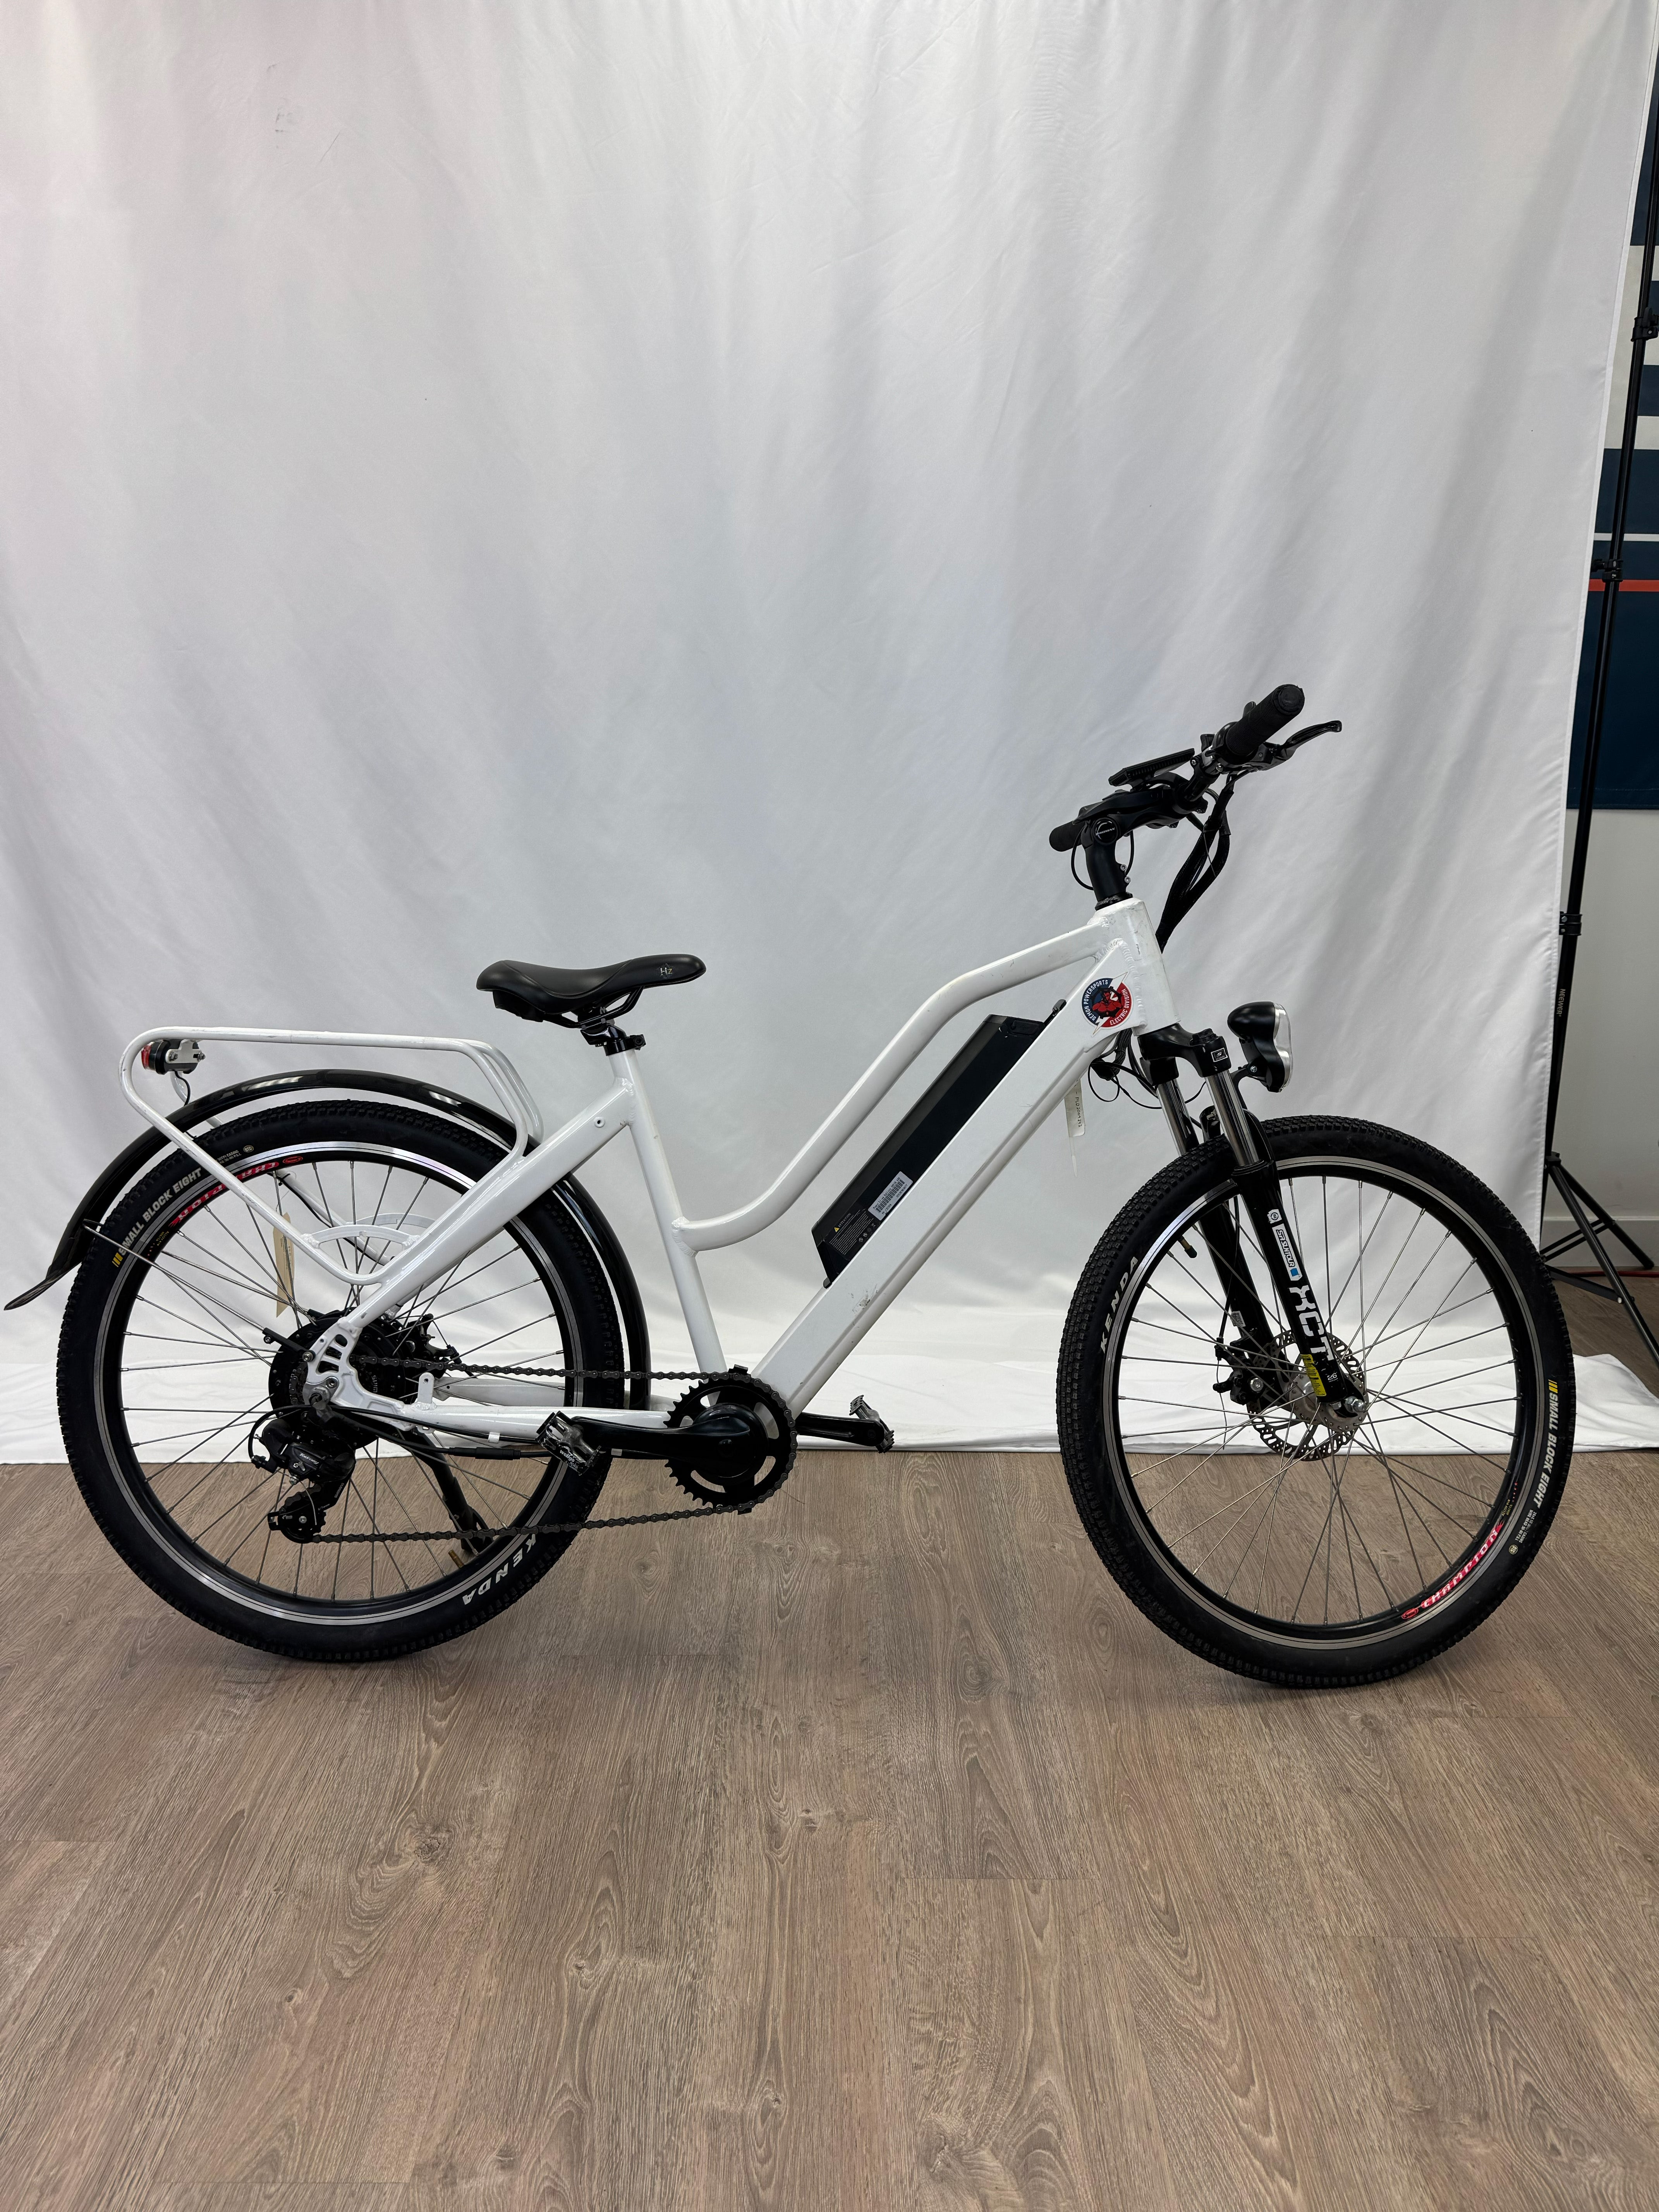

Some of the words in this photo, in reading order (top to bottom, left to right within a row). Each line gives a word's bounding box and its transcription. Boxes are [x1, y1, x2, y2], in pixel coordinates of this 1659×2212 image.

[1084, 980, 1108, 1004] POWERSPORTS
[1110, 1009, 1127, 1025] ELECTRIC
[1121, 988, 1130, 1008] DIVISION
[1556, 989, 1566, 1014] NEEWER
[1084, 1006, 1096, 1021] DEMON
[120, 1221, 145, 1255] SMALL
[142, 1189, 173, 1222] BLOCK
[173, 1167, 202, 1194] EIGHT
[1278, 1242, 1295, 1268] SUNTOUR
[1101, 1256, 1138, 1353] KENDA
[1289, 1286, 1334, 1360] XCT
[1549, 1393, 1559, 1430] SMALL
[1544, 1431, 1558, 1473] BLOCK
[1535, 1471, 1551, 1508] EIGHT
[462, 1534, 536, 1605] KENDA
